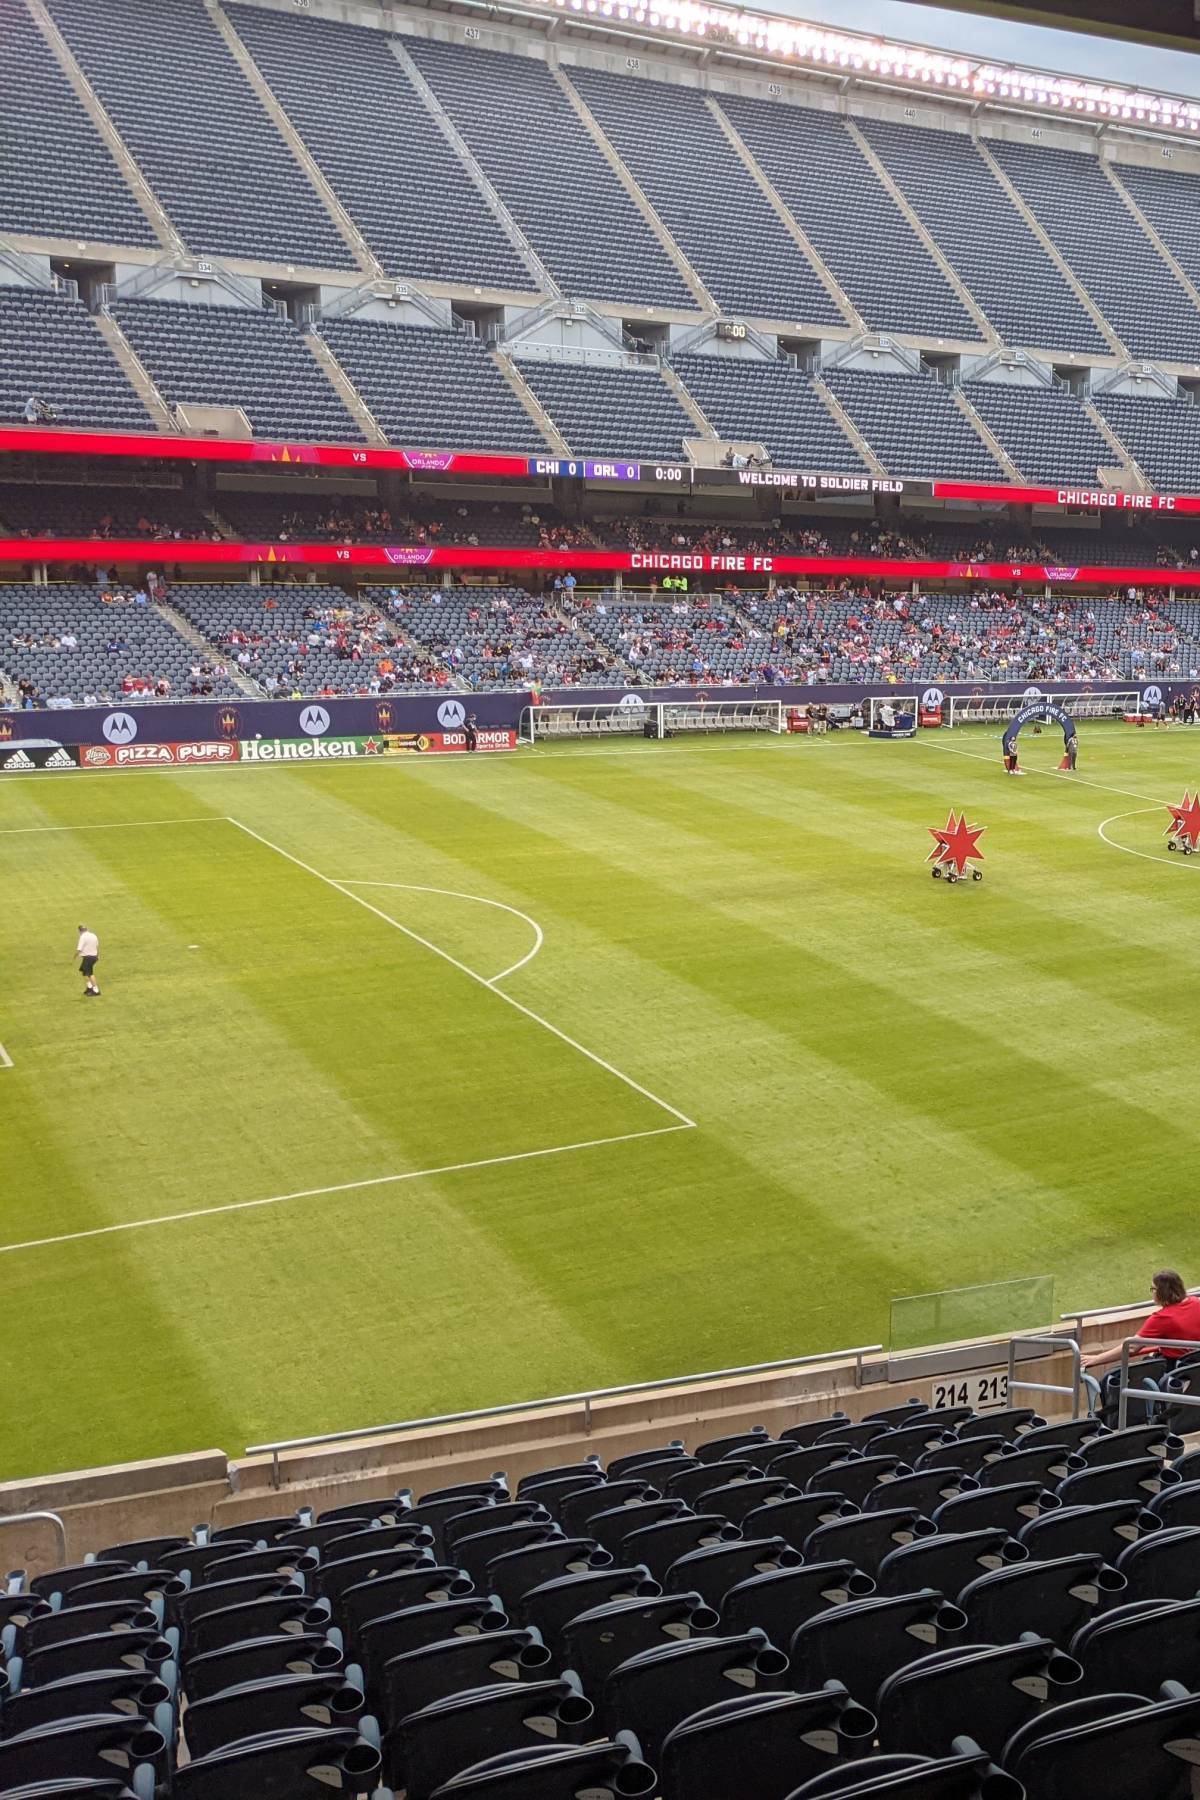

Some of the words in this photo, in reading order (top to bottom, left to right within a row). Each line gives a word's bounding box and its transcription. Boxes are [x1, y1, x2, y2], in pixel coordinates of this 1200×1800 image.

[465, 28, 479, 39] 437
[627, 58, 639, 69] 438
[199, 263, 211, 271] 334
[352, 453, 367, 462] VS
[411, 458, 445, 467] ORLANDO
[536, 461, 559, 474] CHI
[568, 462, 577, 475] 0
[593, 464, 619, 477] ORL
[626, 464, 635, 478] 0
[655, 467, 682, 481] 0:00
[738, 471, 798, 486] WELCOME
[801, 475, 817, 487] TO
[820, 476, 868, 491] SOLDIER
[871, 480, 904, 493] FIELD
[1057, 490, 1117, 506] CHICAGO
[1123, 494, 1152, 508] FIRE
[1158, 496, 1175, 510] FC
[336, 550, 350, 559] VS
[631, 553, 703, 570] CHICAGO
[710, 555, 746, 571] FIRE
[753, 557, 773, 571] FC
[1017, 705, 1044, 724] CHICAGO
[1045, 705, 1060, 717] FIRE
[1058, 711, 1068, 722] FC
[443, 731, 510, 745] BODRMOR
[117, 747, 172, 762] PIZZA
[179, 745, 231, 760] PUFF
[240, 737, 358, 760] Heineken
[3, 761, 36, 769] adidas
[45, 759, 77, 768] adidas
[935, 1382, 969, 1408] 214
[978, 1375, 1008, 1401] 213
